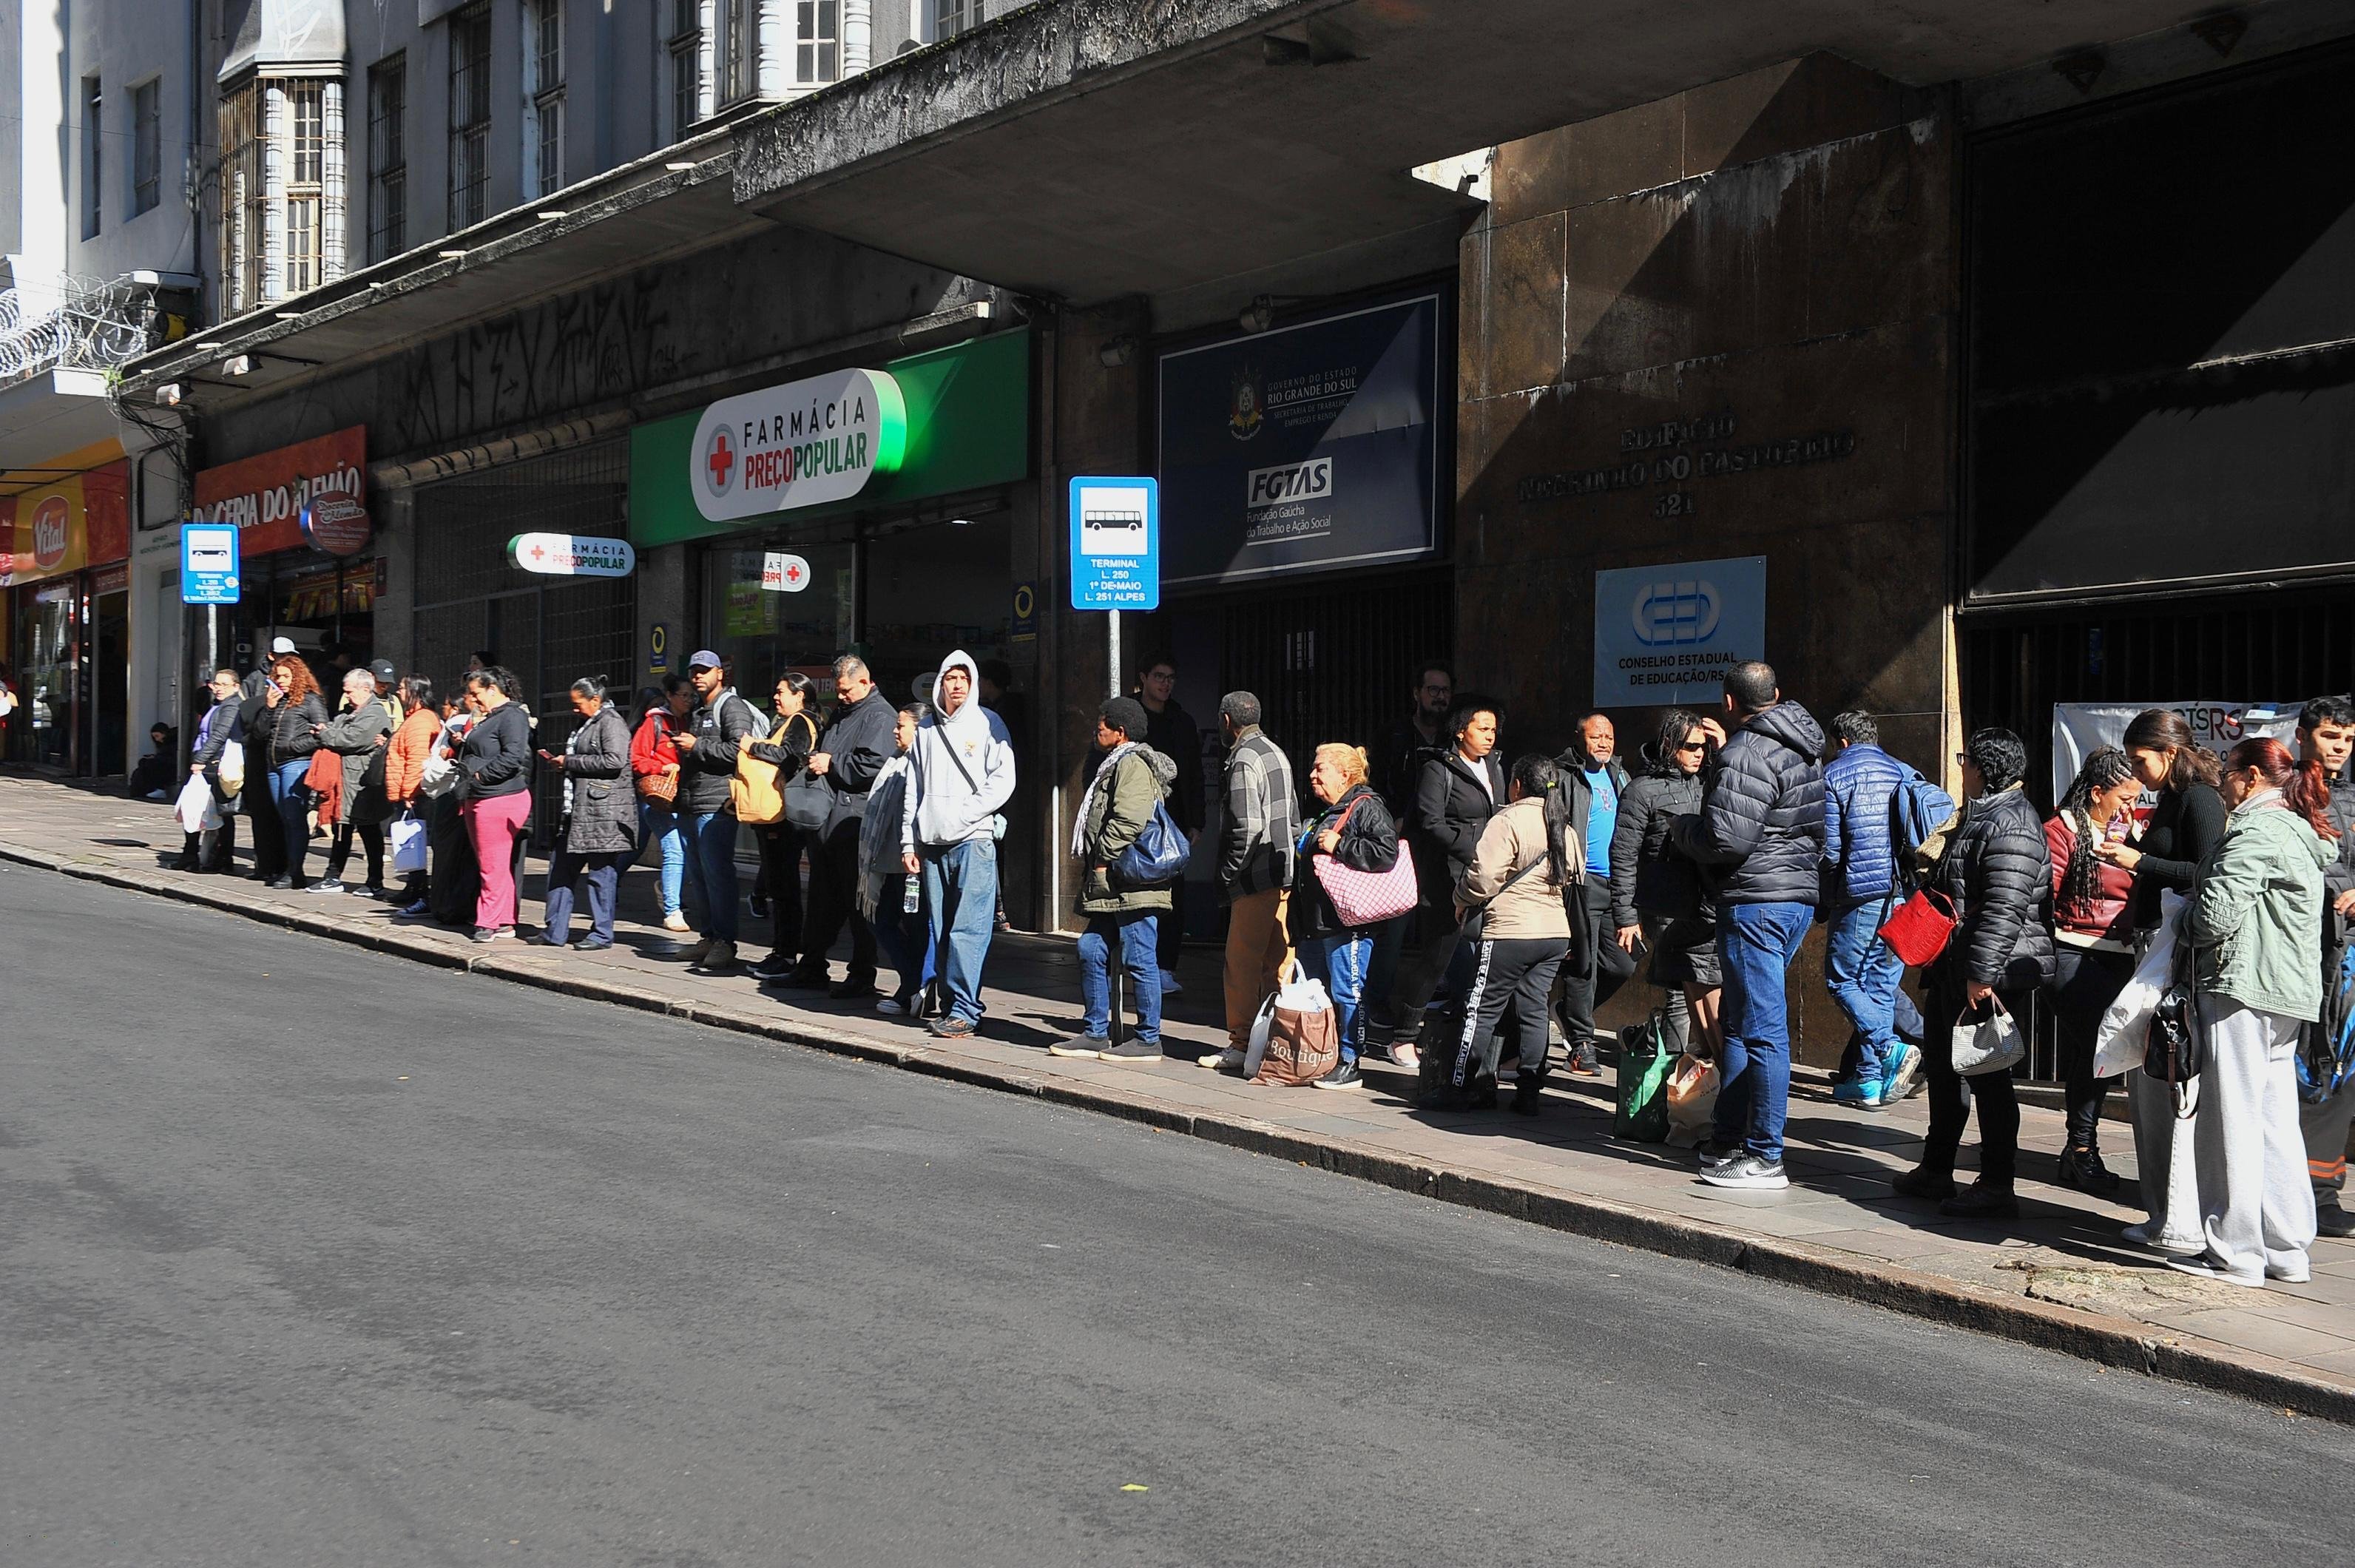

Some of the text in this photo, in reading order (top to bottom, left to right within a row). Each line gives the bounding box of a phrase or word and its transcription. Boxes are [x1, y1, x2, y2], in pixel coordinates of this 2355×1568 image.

[1268, 366, 1356, 391] GOVERNO DO ESTADO
[1268, 377, 1356, 405] RIO GRANDE DO SUL
[744, 396, 865, 448] FARMÁCIA
[745, 432, 867, 491] PREÇOPOPULAR
[1655, 455, 1691, 483] DO
[1699, 431, 1854, 477] PASTOREIO
[1251, 464, 1328, 502] FGTAS
[263, 486, 290, 523] DO
[1247, 504, 1305, 524] Fundação Gaúcha
[1655, 491, 1696, 518] 521
[35, 512, 65, 555] Vital
[1247, 515, 1331, 538] do Trabalho e Ação Social
[1090, 559, 1140, 568] TERMINAL
[1101, 570, 1129, 579] L. 250
[1085, 592, 1146, 601] L. 251 ALPES
[1101, 581, 1115, 590] DE
[1116, 582, 1141, 590] MAIO
[1618, 652, 1737, 669] CONSELHO ESTADUAL
[1630, 669, 1724, 686] DE EDUCAÇÃO/RS
[1271, 1039, 1334, 1067] Boutique
